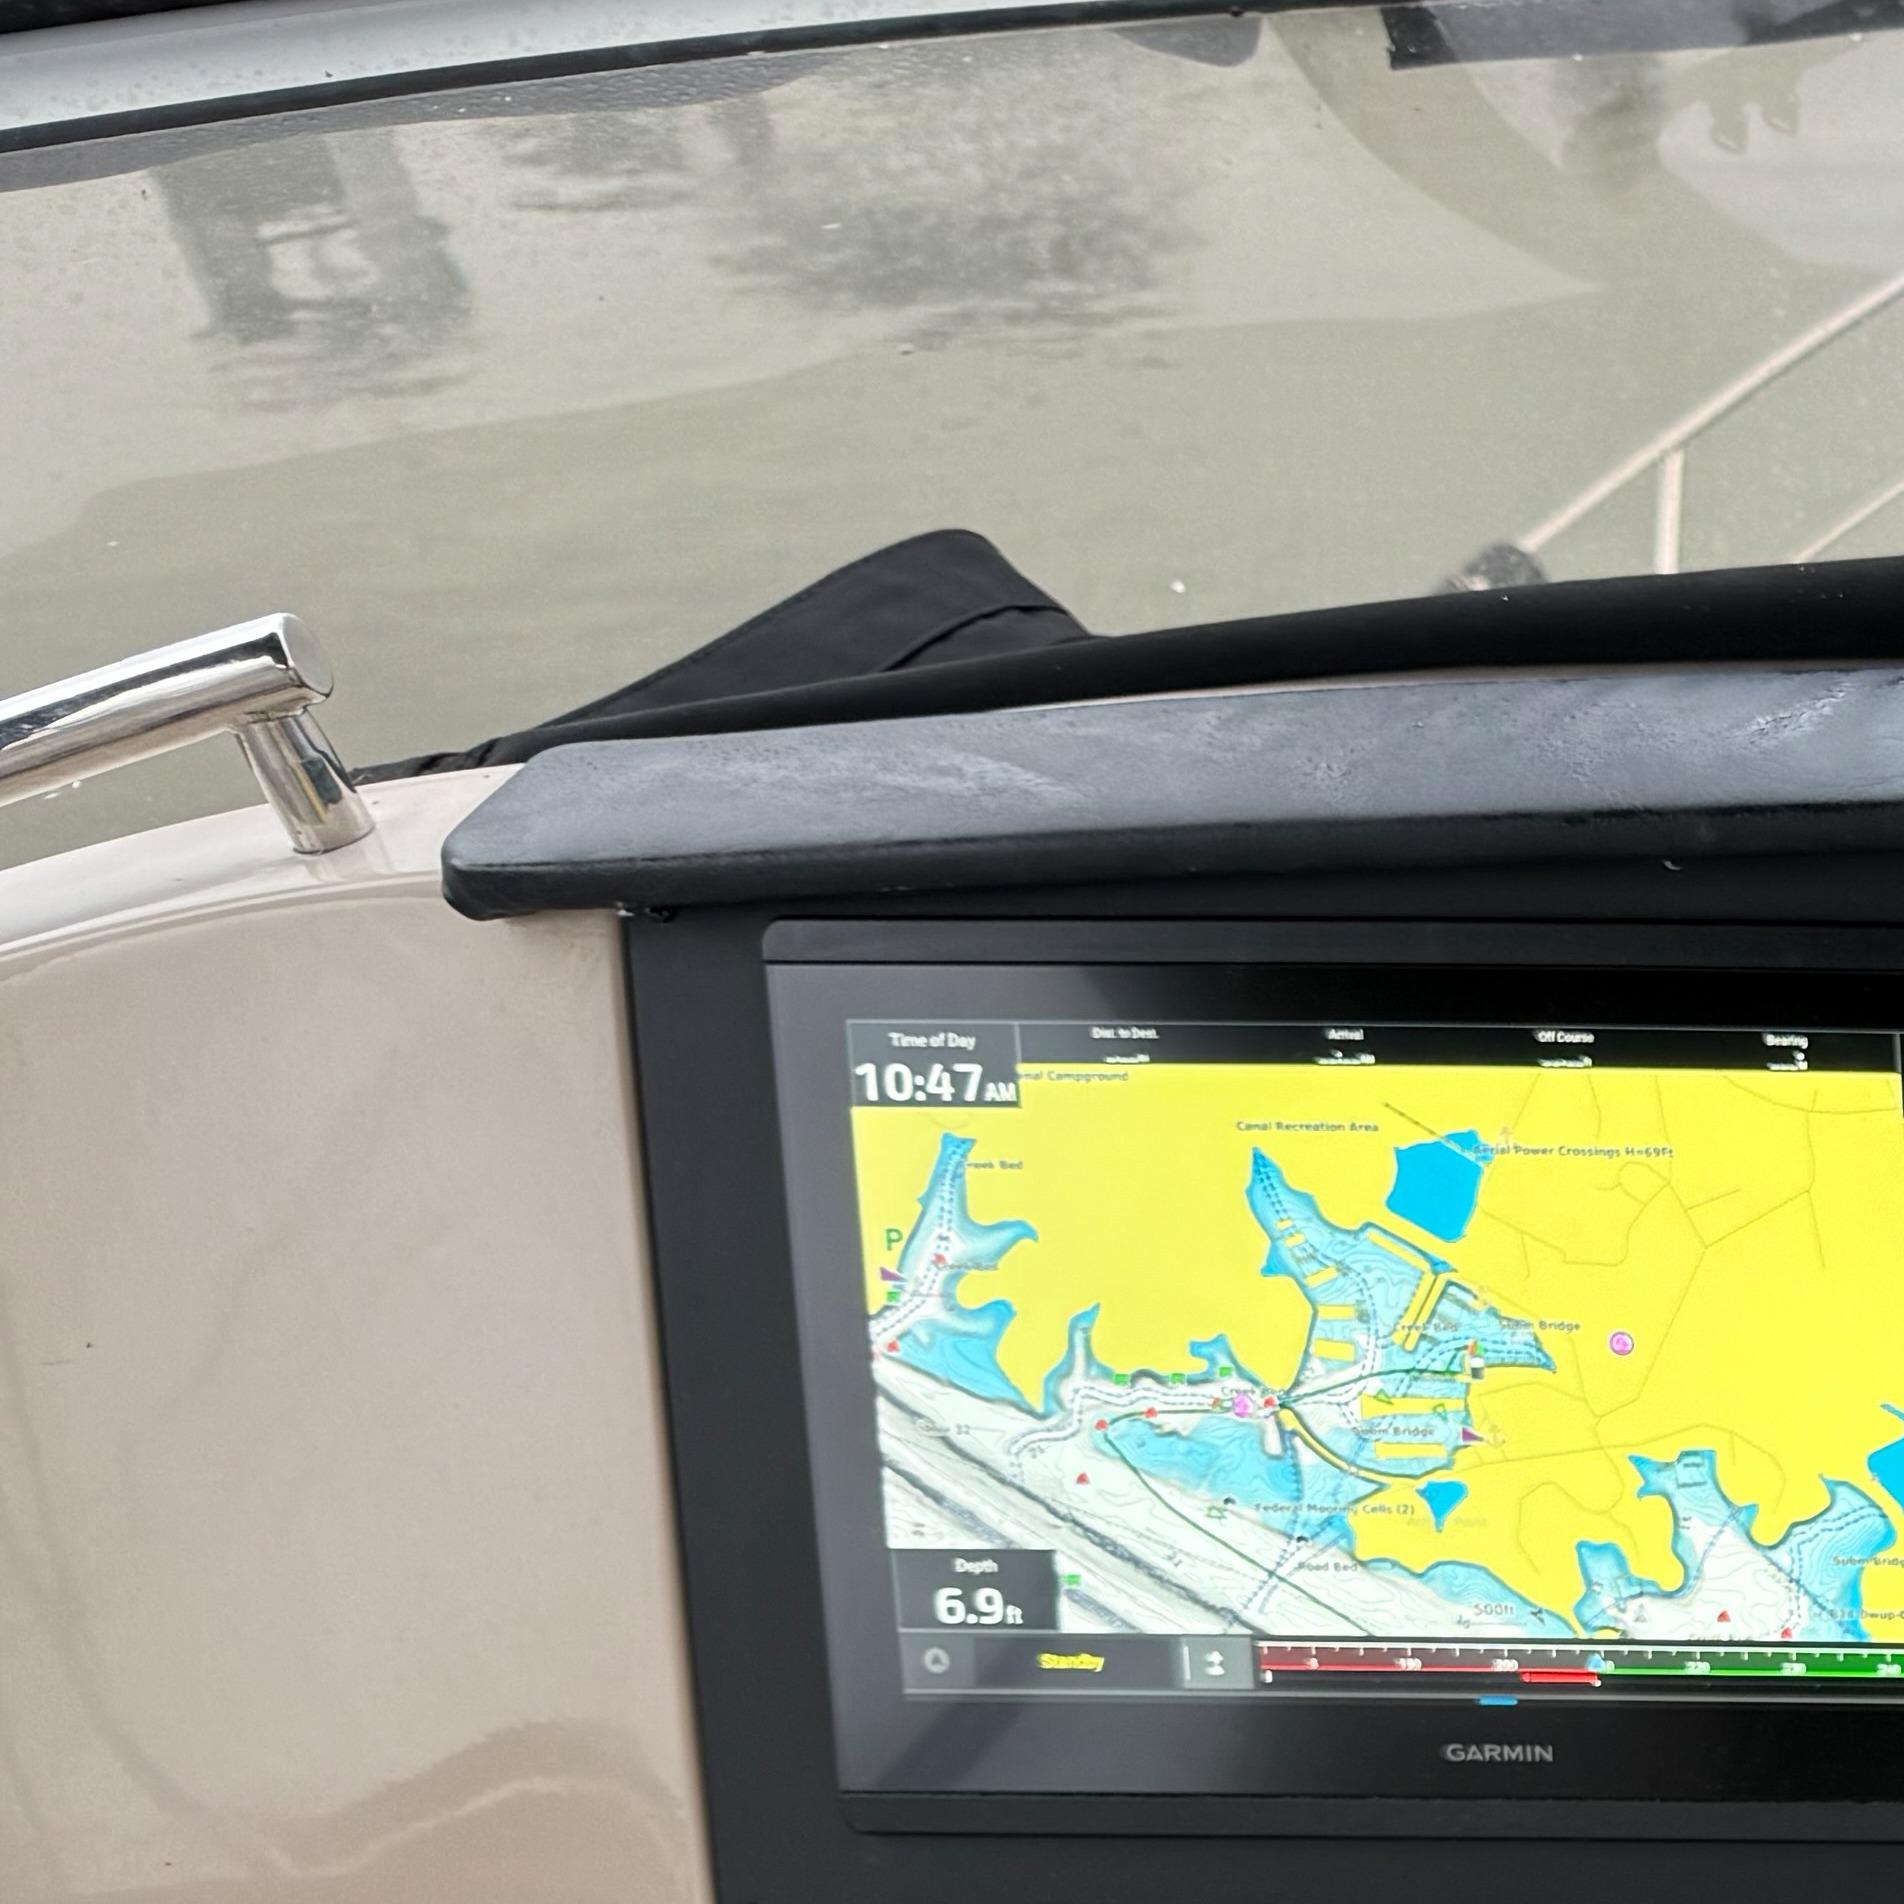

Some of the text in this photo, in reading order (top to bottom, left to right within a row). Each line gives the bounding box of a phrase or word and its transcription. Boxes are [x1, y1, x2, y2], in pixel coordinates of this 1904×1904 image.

[889, 1032, 976, 1050] Time of Day
[1557, 1031, 1595, 1044] Course
[1765, 1034, 1808, 1049] Bearing
[1047, 1070, 1129, 1084] Campground
[1236, 1121, 1379, 1132] Canal Recreation Area
[1514, 1145, 1553, 1157] Power
[1558, 1145, 1621, 1158] Crossings
[1540, 1320, 1581, 1333] Bridge
[1393, 1426, 1435, 1438] Bridge
[1255, 1503, 1301, 1515] Federal
[1362, 1503, 1392, 1515] Cells
[954, 1557, 998, 1574] Depth
[1473, 1603, 1514, 1616] 500ft
[1037, 1653, 1104, 1671] Standby
[1443, 1742, 1554, 1761] GARMIN
